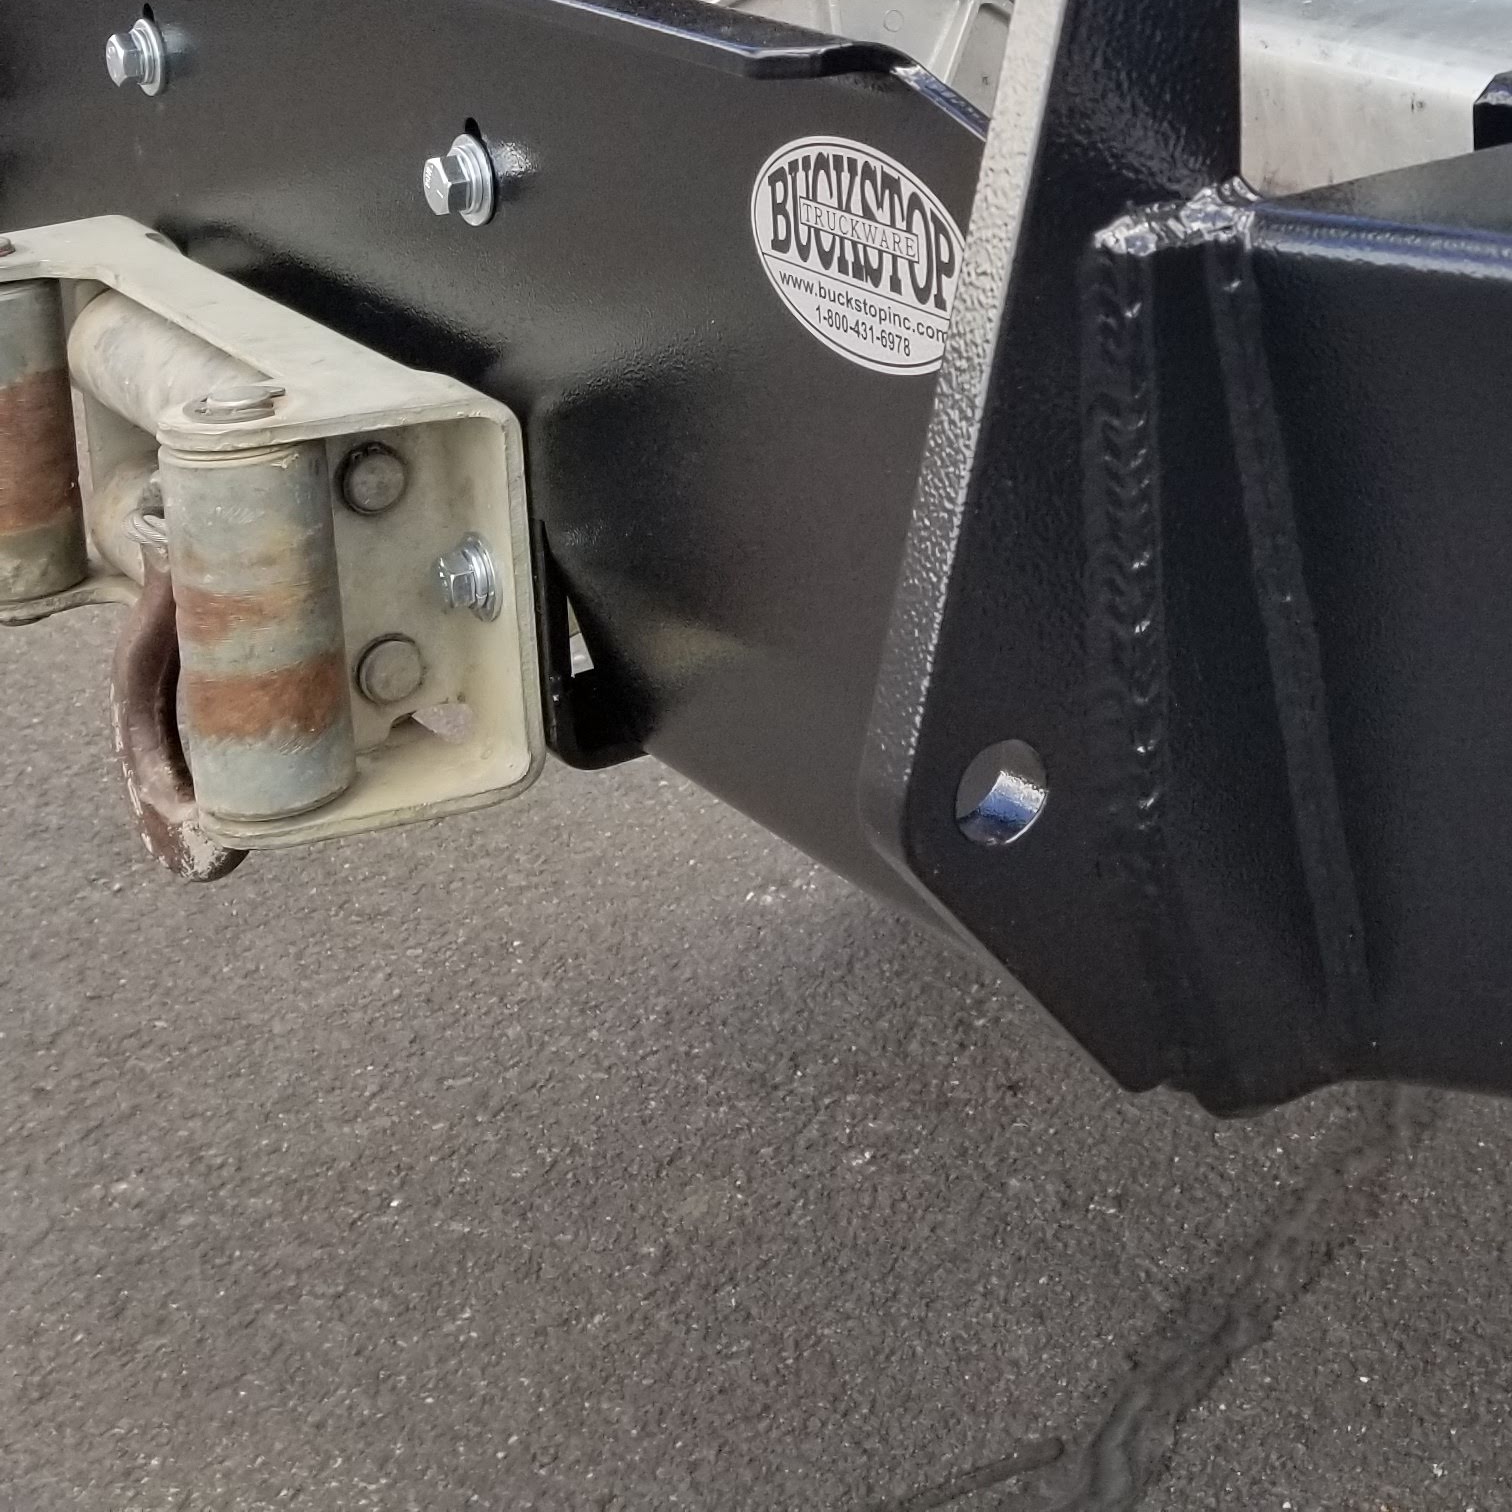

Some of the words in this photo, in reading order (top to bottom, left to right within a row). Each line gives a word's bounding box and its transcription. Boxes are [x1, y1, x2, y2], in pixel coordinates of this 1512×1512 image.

[767, 152, 955, 311] BUCKSTOP
[803, 203, 916, 257] TRUCKWARE
[779, 271, 948, 343] www.buckstopinc.com
[815, 305, 911, 356] 1-800-431-6978
